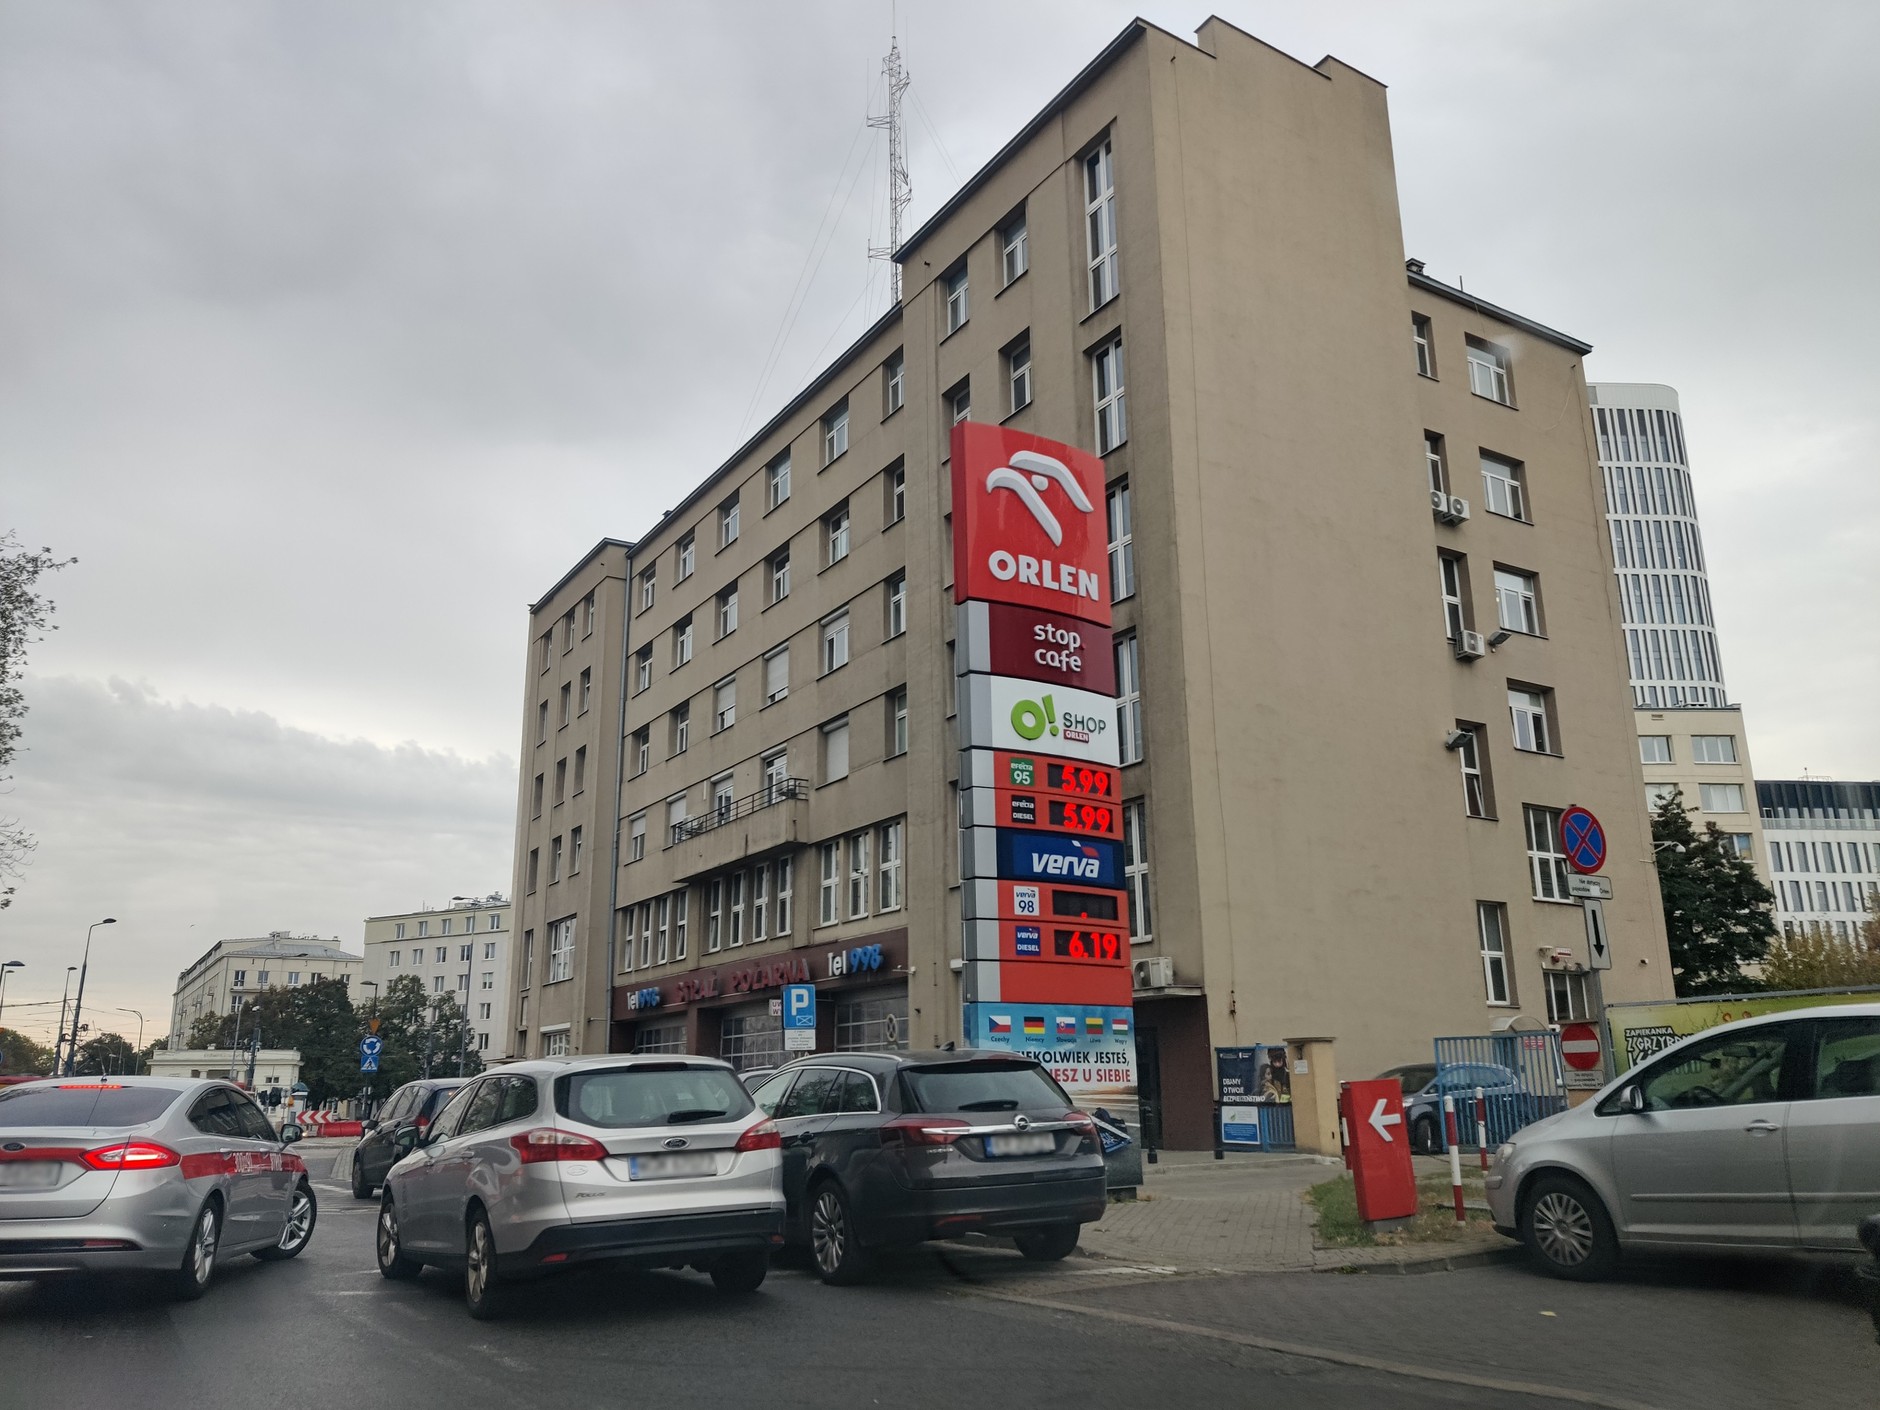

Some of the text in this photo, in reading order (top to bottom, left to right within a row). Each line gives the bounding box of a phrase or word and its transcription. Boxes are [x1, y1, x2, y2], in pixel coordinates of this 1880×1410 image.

[988, 550, 1099, 602] ORLEN
[1033, 622, 1081, 652] stop
[1034, 648, 1082, 672] cafe
[1010, 693, 1107, 741] O! SHOP
[1065, 731, 1089, 742] ORLEN
[1014, 765, 1109, 797] 95 5.99
[1013, 802, 1111, 833] DIESEL 5.99
[1031, 851, 1100, 879] verva
[1016, 891, 1036, 899] verva
[1018, 900, 1035, 914] 98
[1017, 931, 1118, 960] verva 6.19
[1017, 943, 1040, 952] DIESEL
[828, 943, 884, 977] Tel 998
[627, 991, 639, 1010] Tel
[791, 988, 809, 1016] P
[1625, 1027, 1674, 1037] ZAPIEKANKA
[1094, 1049, 1130, 1067] JESTEŚ,
[1082, 1069, 1092, 1082] U
[1096, 1069, 1131, 1083] SIEBIE
